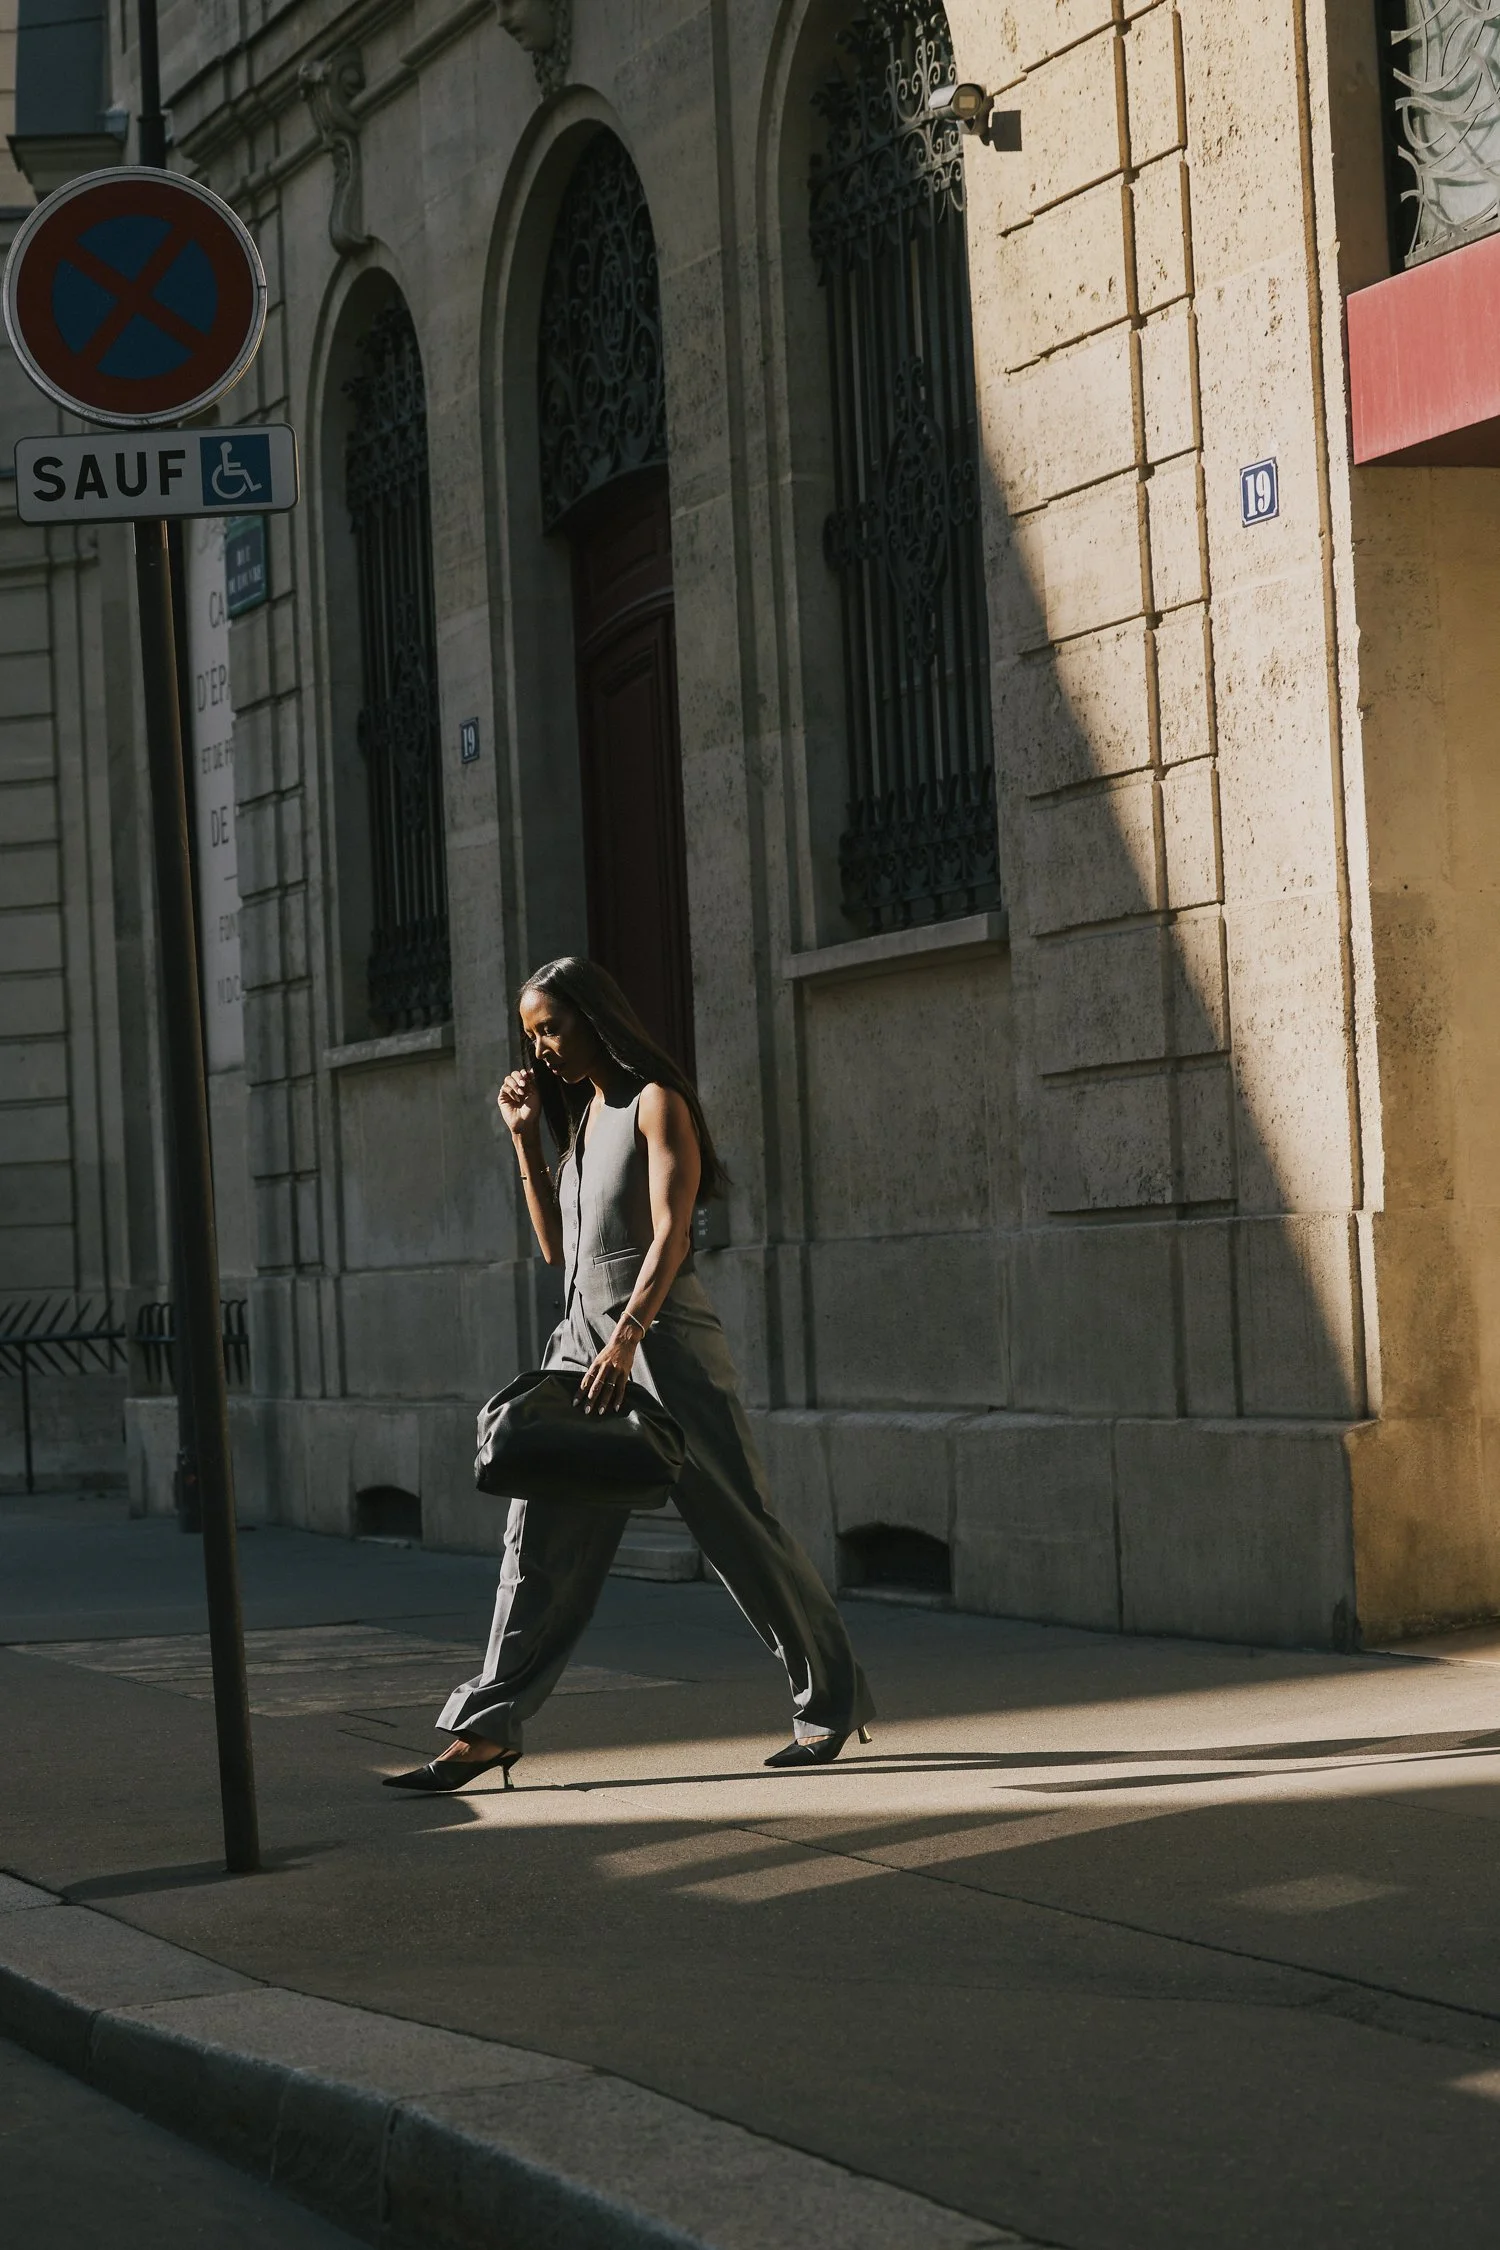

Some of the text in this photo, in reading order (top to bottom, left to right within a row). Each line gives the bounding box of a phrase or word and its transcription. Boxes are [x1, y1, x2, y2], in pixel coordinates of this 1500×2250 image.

[33, 450, 186, 502] SAUF
[1245, 470, 1272, 518] 19
[463, 726, 476, 758] 19
[211, 806, 229, 847] DE
